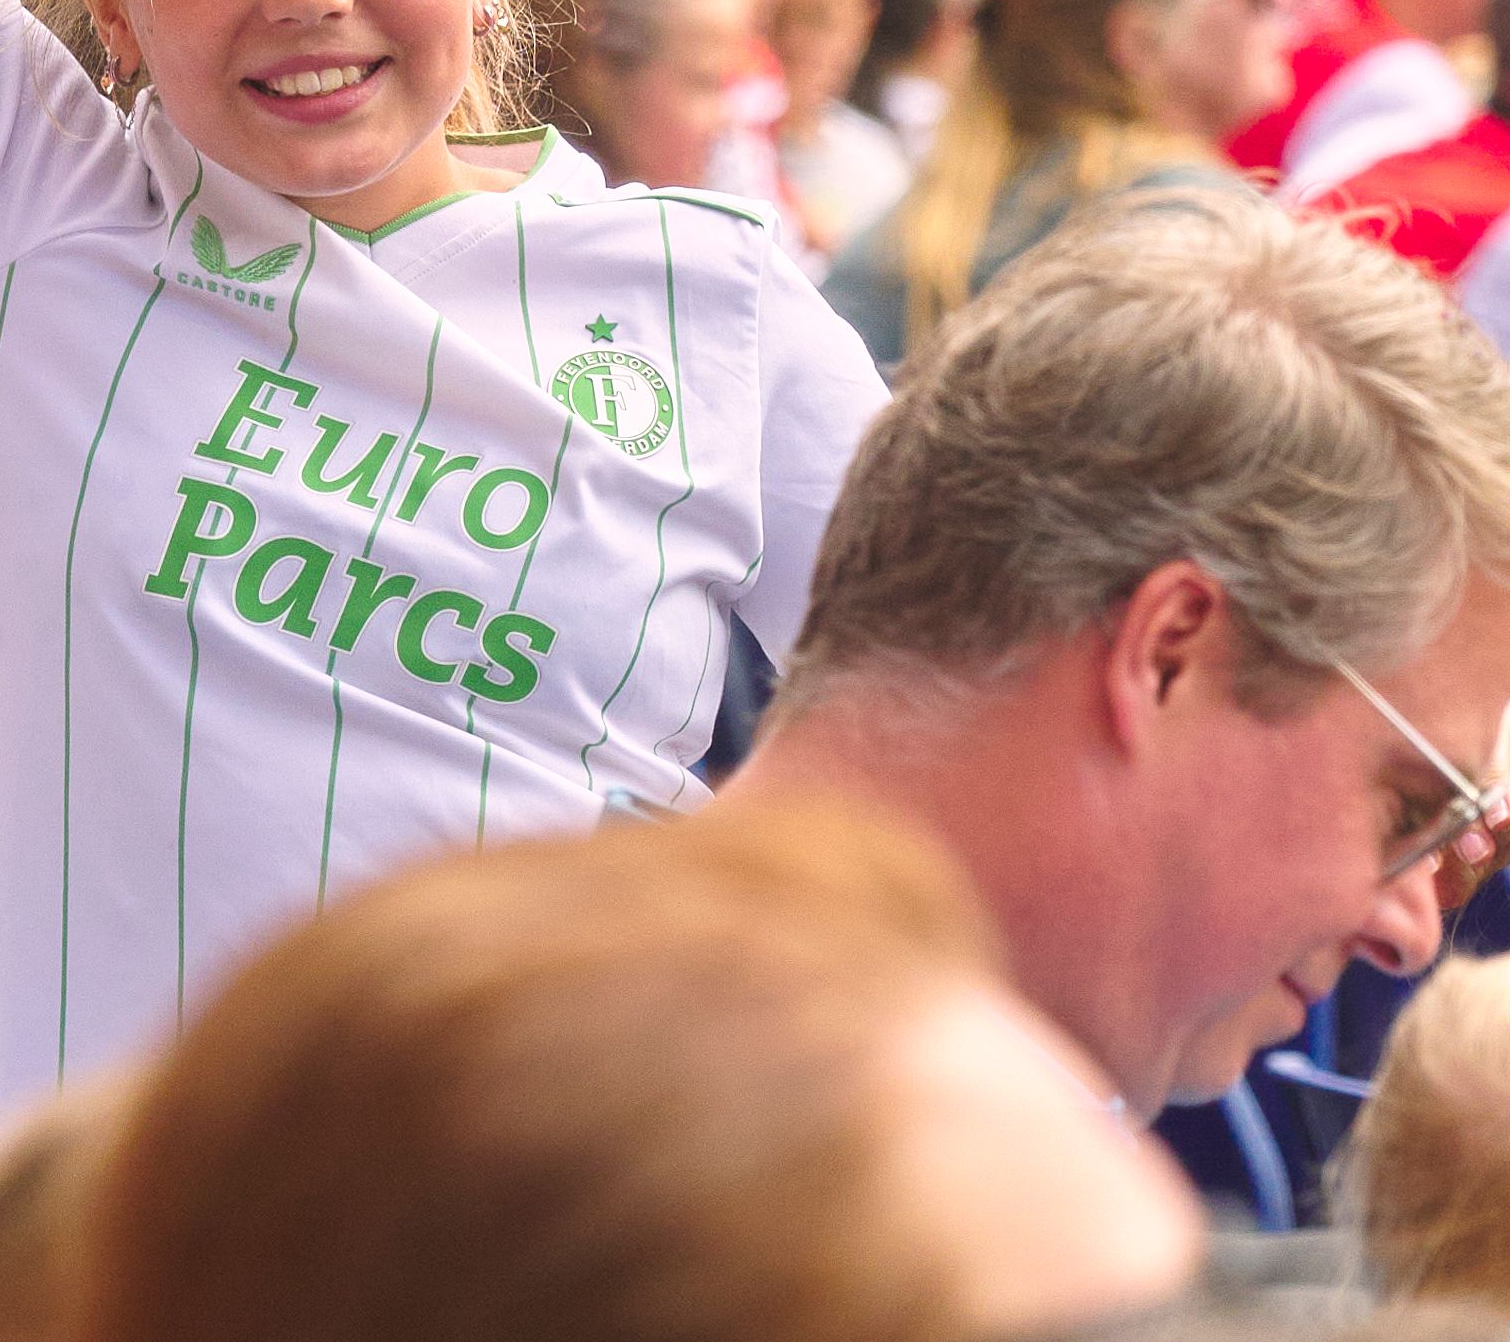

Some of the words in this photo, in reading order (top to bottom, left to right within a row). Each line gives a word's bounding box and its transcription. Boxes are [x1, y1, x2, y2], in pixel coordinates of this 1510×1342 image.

[177, 271, 276, 312] CASTORE
[556, 351, 665, 391] FEYENOORD
[194, 358, 551, 550] Euro
[144, 476, 558, 703] Parcs
